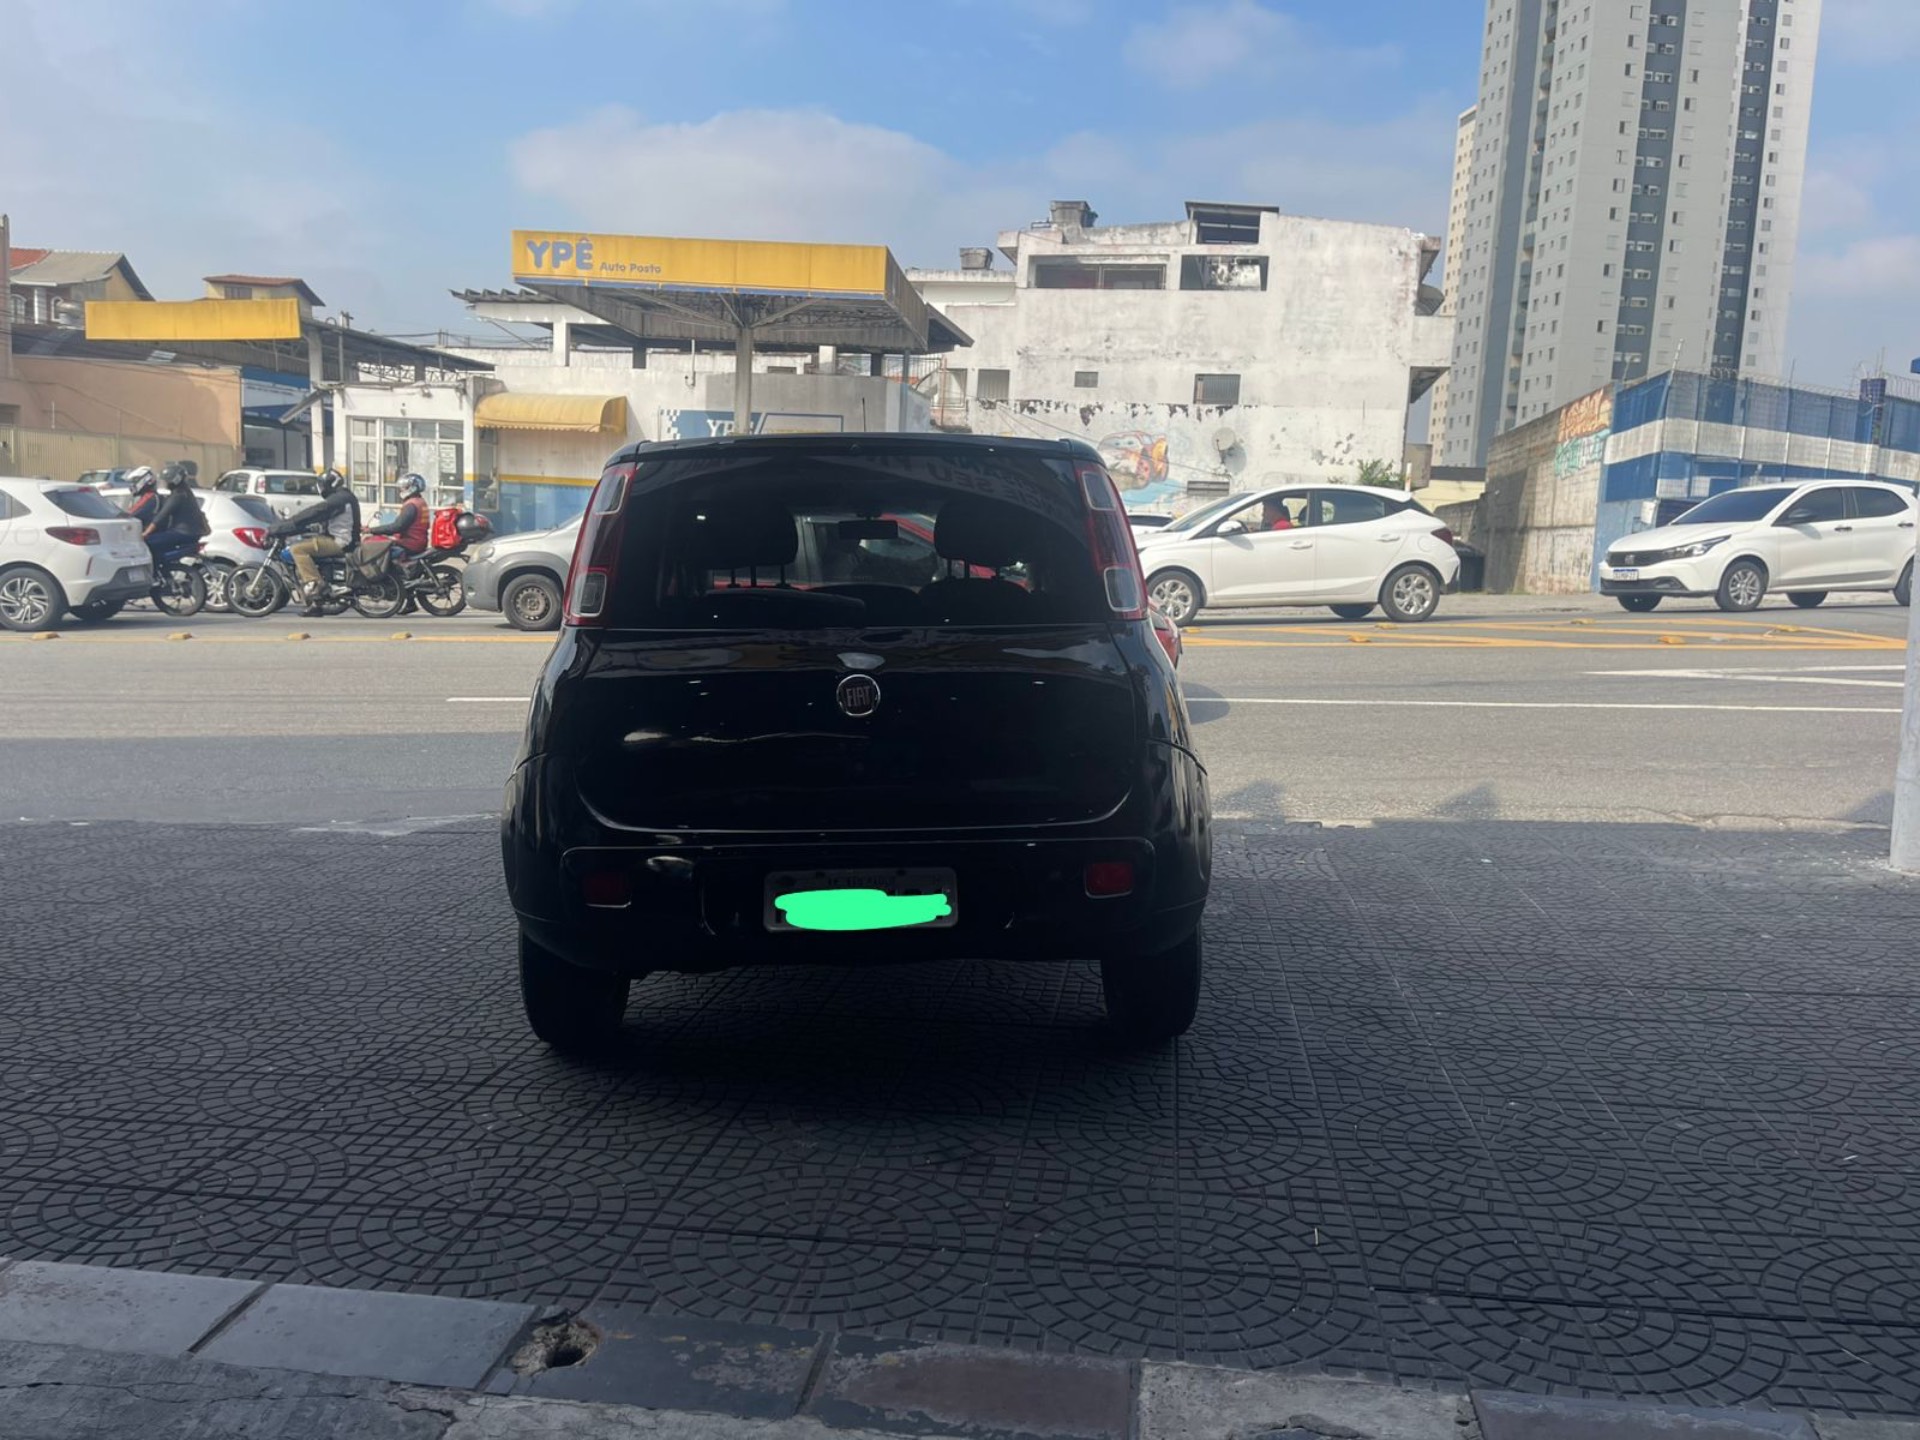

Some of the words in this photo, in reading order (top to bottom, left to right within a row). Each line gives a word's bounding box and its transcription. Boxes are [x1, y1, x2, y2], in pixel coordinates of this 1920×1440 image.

[527, 236, 593, 270] YPÊ
[600, 261, 626, 273] Auto
[629, 263, 662, 274] Posto
[846, 686, 871, 707] FIAT
